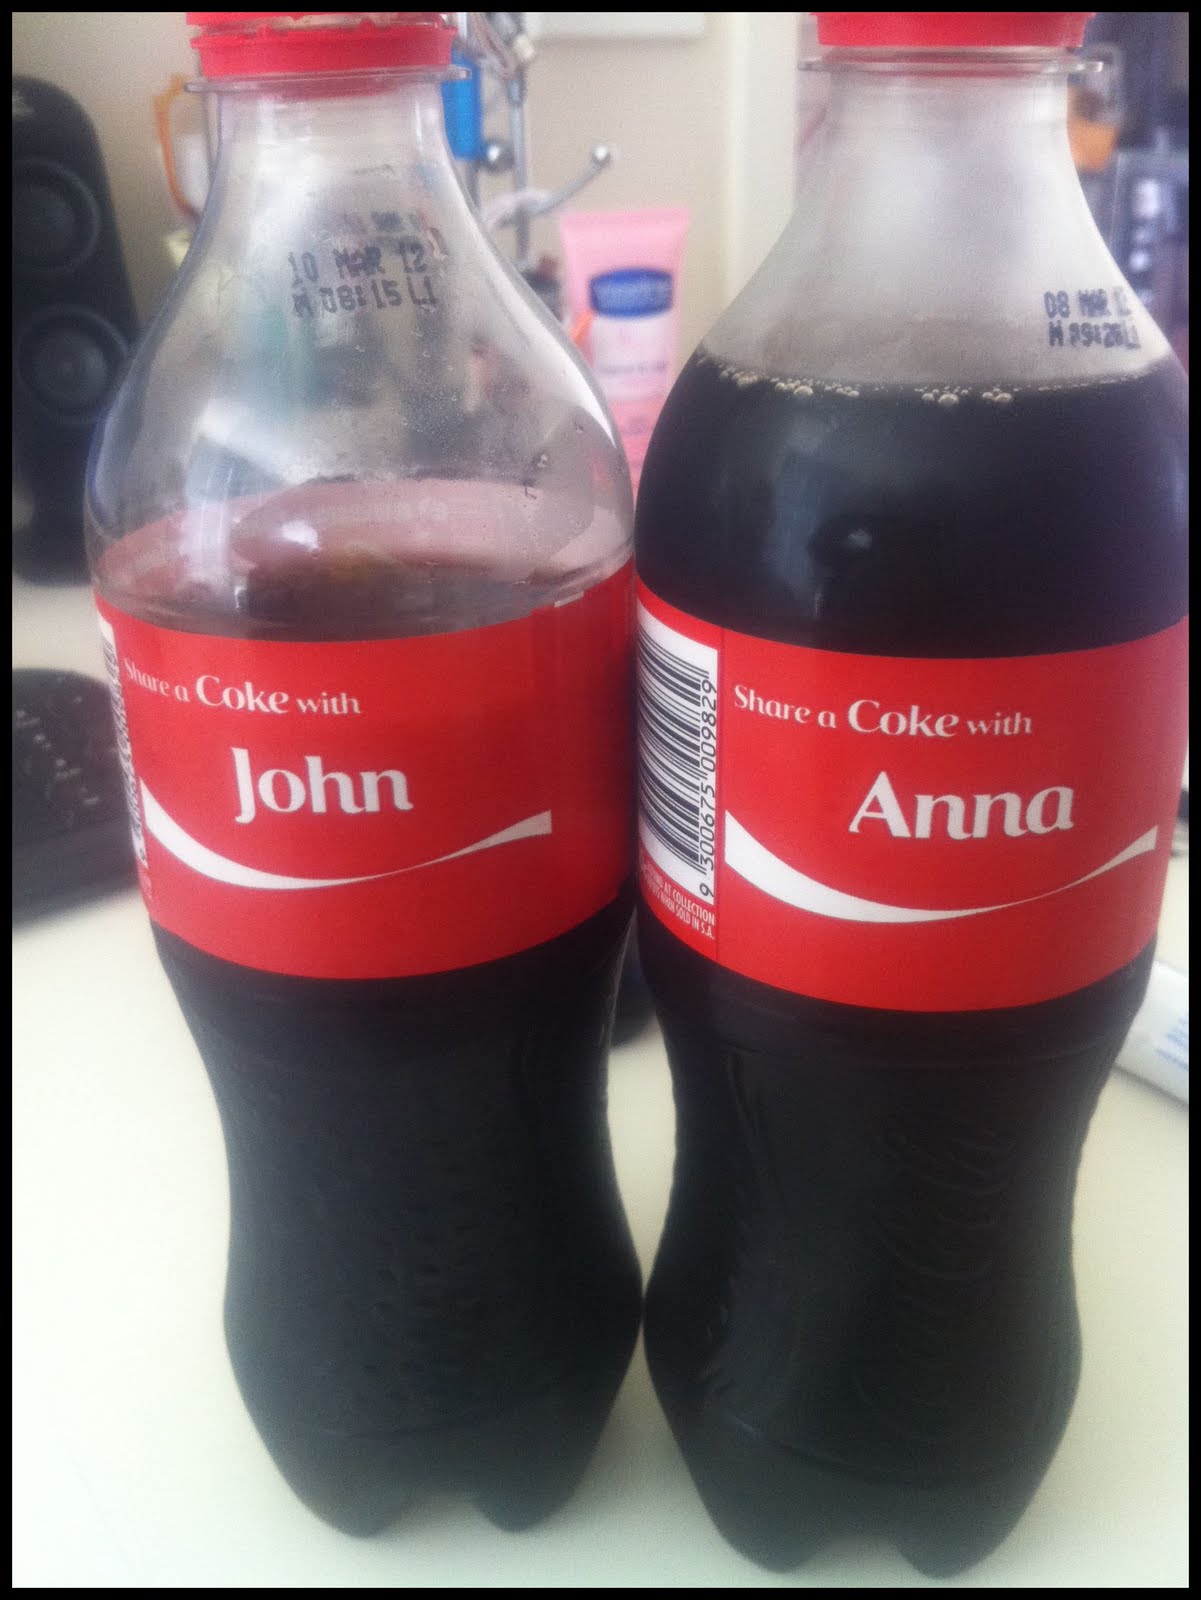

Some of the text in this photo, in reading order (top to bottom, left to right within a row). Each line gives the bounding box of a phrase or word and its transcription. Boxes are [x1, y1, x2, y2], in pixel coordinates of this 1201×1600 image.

[288, 244, 427, 282] 10 MAR 12
[1043, 290, 1071, 319] 08
[124, 657, 361, 715] Share a Coke with
[734, 685, 1032, 737] Share a Coke with
[231, 746, 414, 825] John
[699, 679, 717, 898] 9 300675 009829
[848, 771, 1074, 840] Anna
[672, 889, 715, 926] COLLECTION
[675, 904, 691, 925] SOLD
[691, 915, 700, 931] IN
